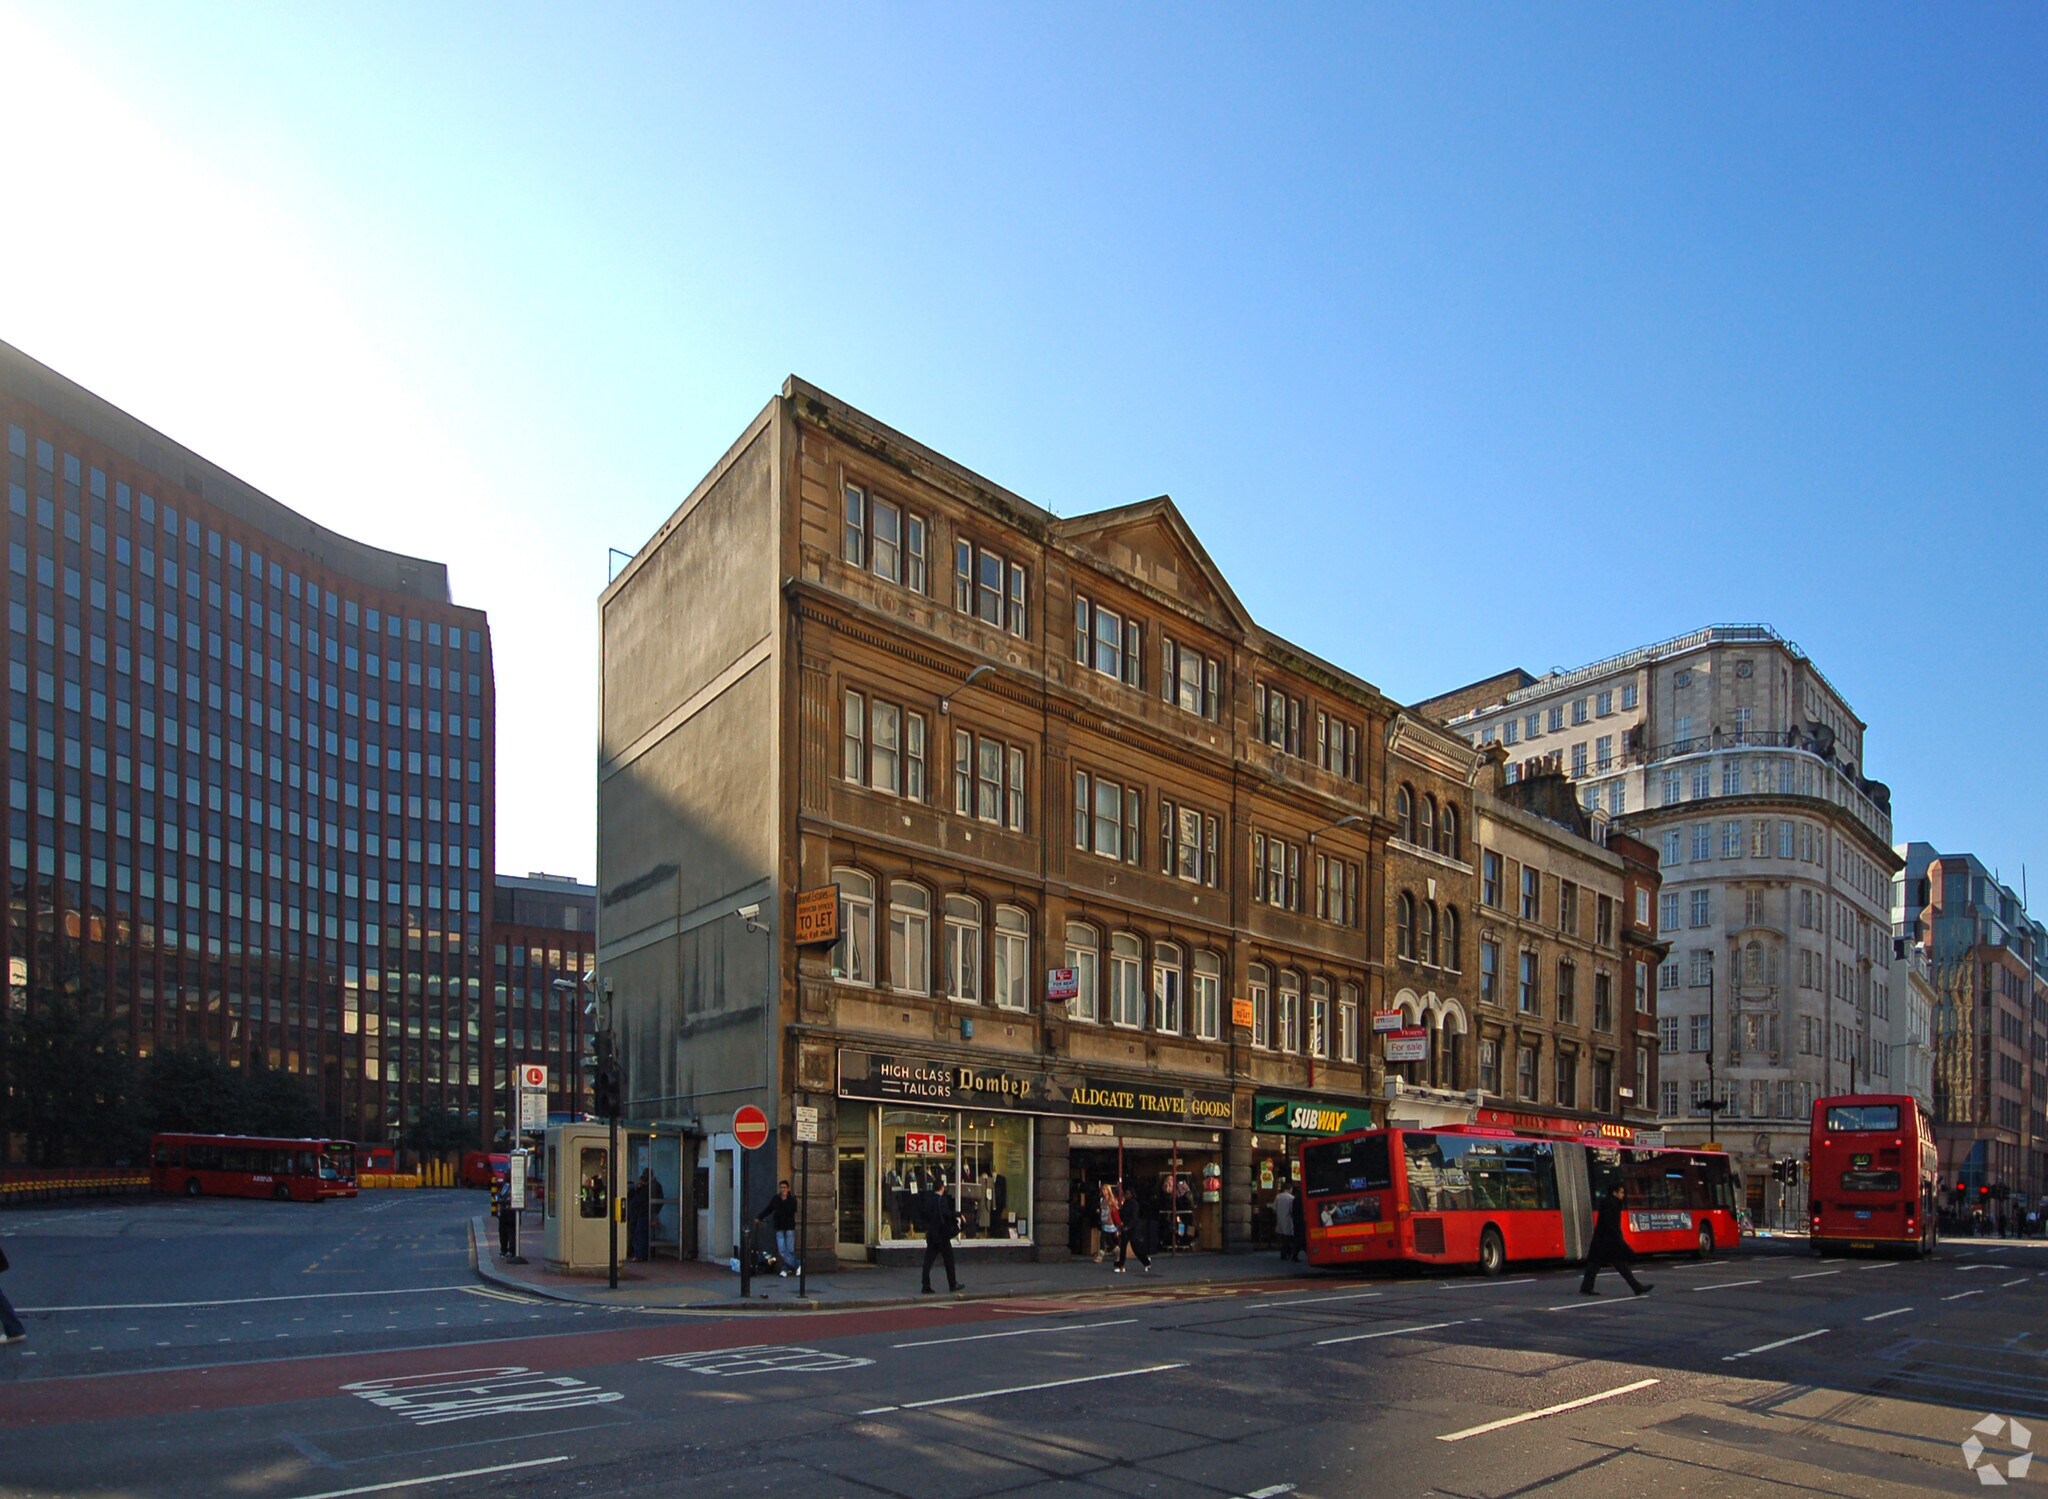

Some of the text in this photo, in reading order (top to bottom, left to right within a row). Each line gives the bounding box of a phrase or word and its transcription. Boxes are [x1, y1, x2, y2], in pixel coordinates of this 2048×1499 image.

[800, 911, 832, 929] TO LET
[1391, 1042, 1423, 1052] For sale
[531, 1070, 539, 1082] L
[881, 1063, 951, 1083] HIGH CLASS
[902, 1081, 951, 1098] TAILORS
[959, 1068, 1030, 1099] Dombey
[1070, 1087, 1231, 1118] ALDGATE TRAVEL GOODS
[1291, 1107, 1348, 1132] SUBWAY
[908, 1135, 944, 1153] sale
[1340, 1143, 1352, 1155] 25
[1854, 1154, 1869, 1164] 40
